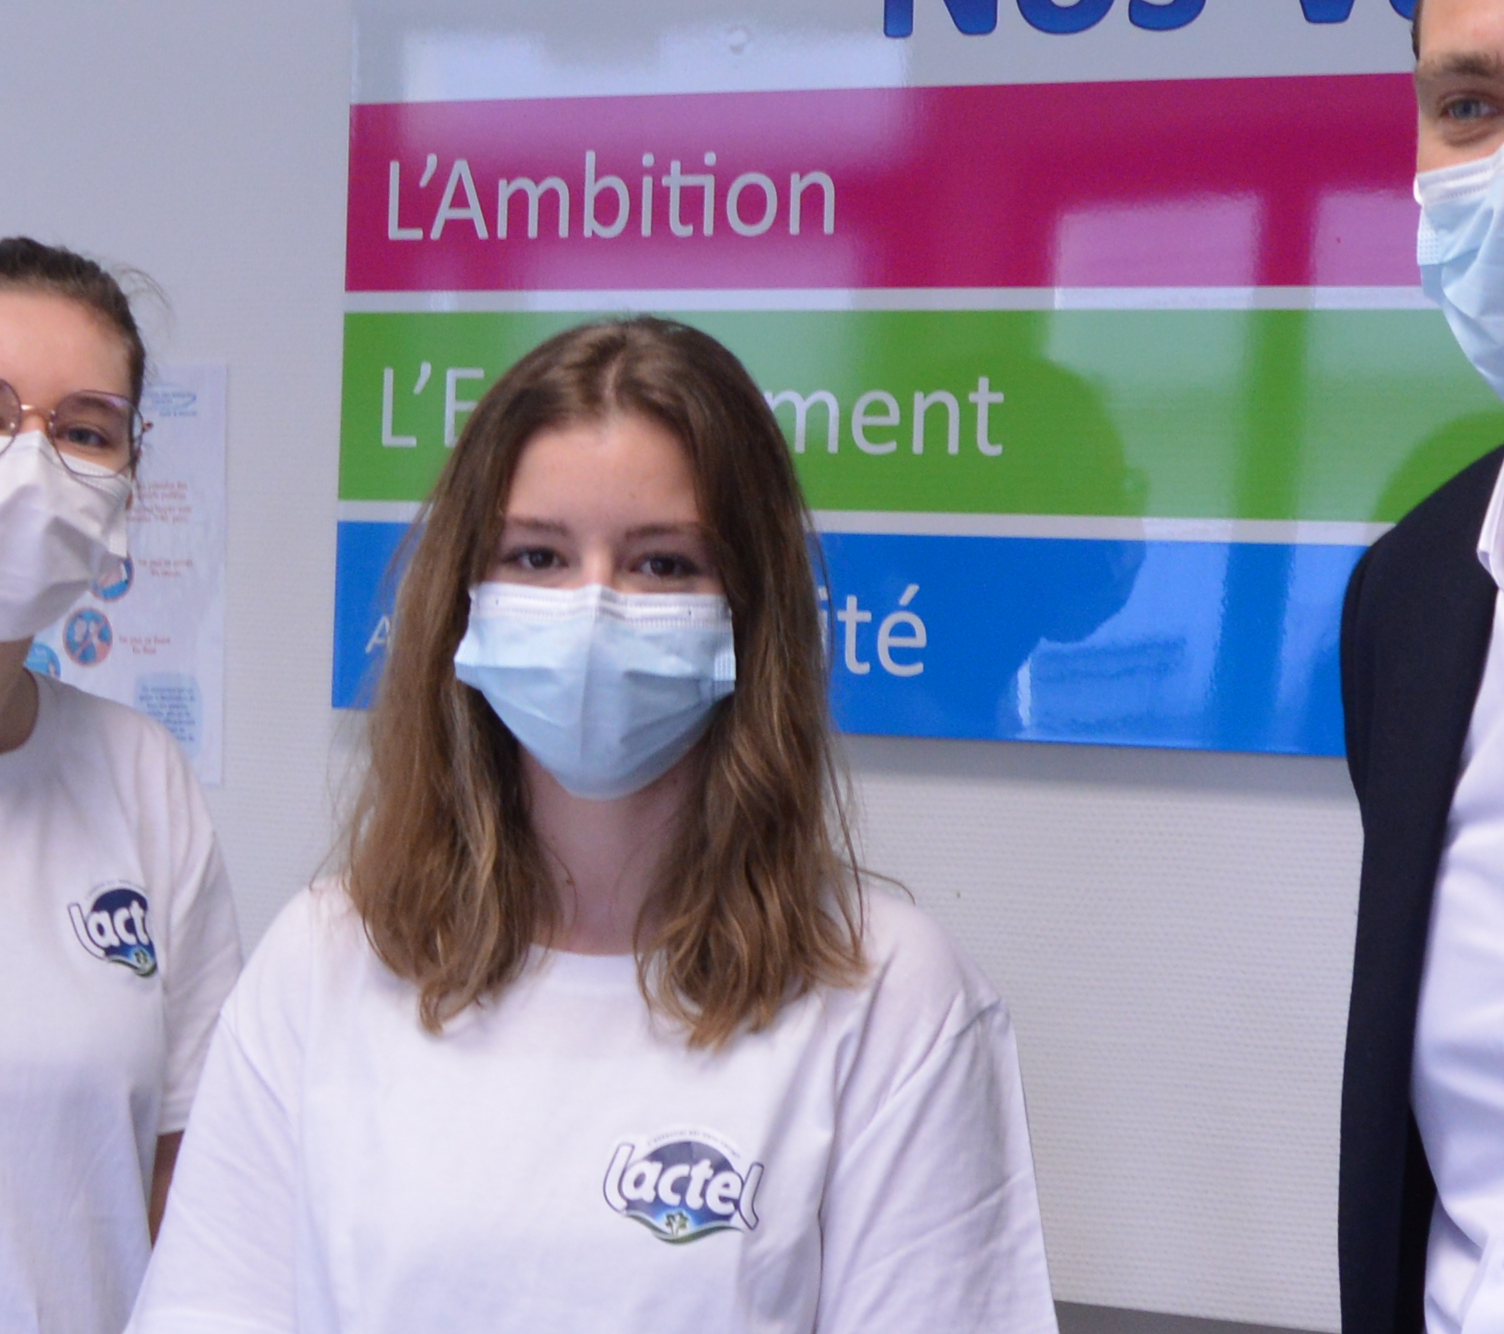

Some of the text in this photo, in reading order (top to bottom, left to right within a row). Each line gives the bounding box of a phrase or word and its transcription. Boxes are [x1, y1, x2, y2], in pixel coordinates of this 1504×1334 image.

[386, 152, 837, 241] L'Ambition
[67, 900, 150, 962] lact
[602, 1142, 765, 1231] lactel
